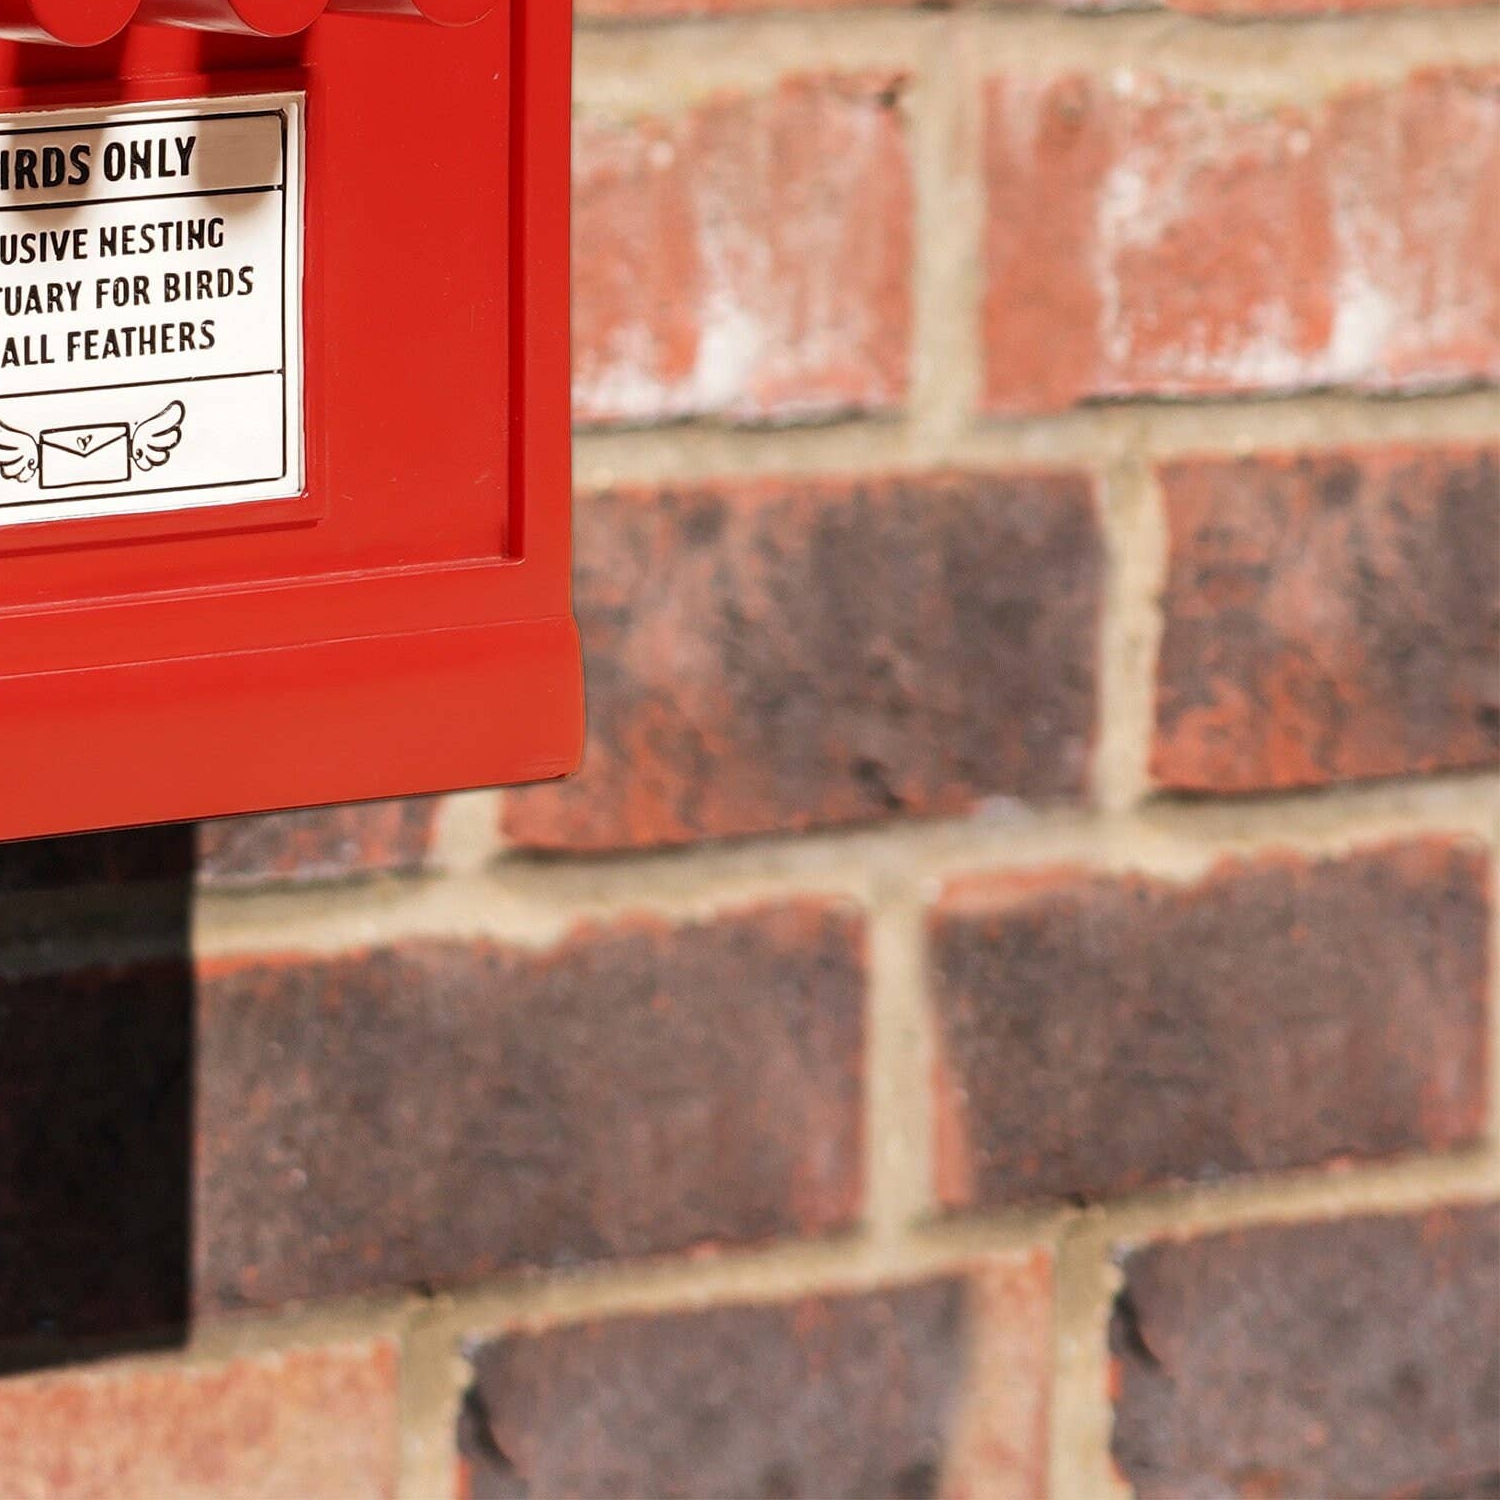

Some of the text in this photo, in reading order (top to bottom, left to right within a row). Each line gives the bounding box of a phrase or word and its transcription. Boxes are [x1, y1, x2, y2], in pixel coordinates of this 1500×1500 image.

[103, 136, 197, 182] ONLY
[99, 217, 225, 258] NESTING
[95, 275, 150, 309] FOR
[163, 266, 255, 303] BIRDS
[1, 334, 55, 368] ALL
[67, 320, 216, 363] FEATHERS
